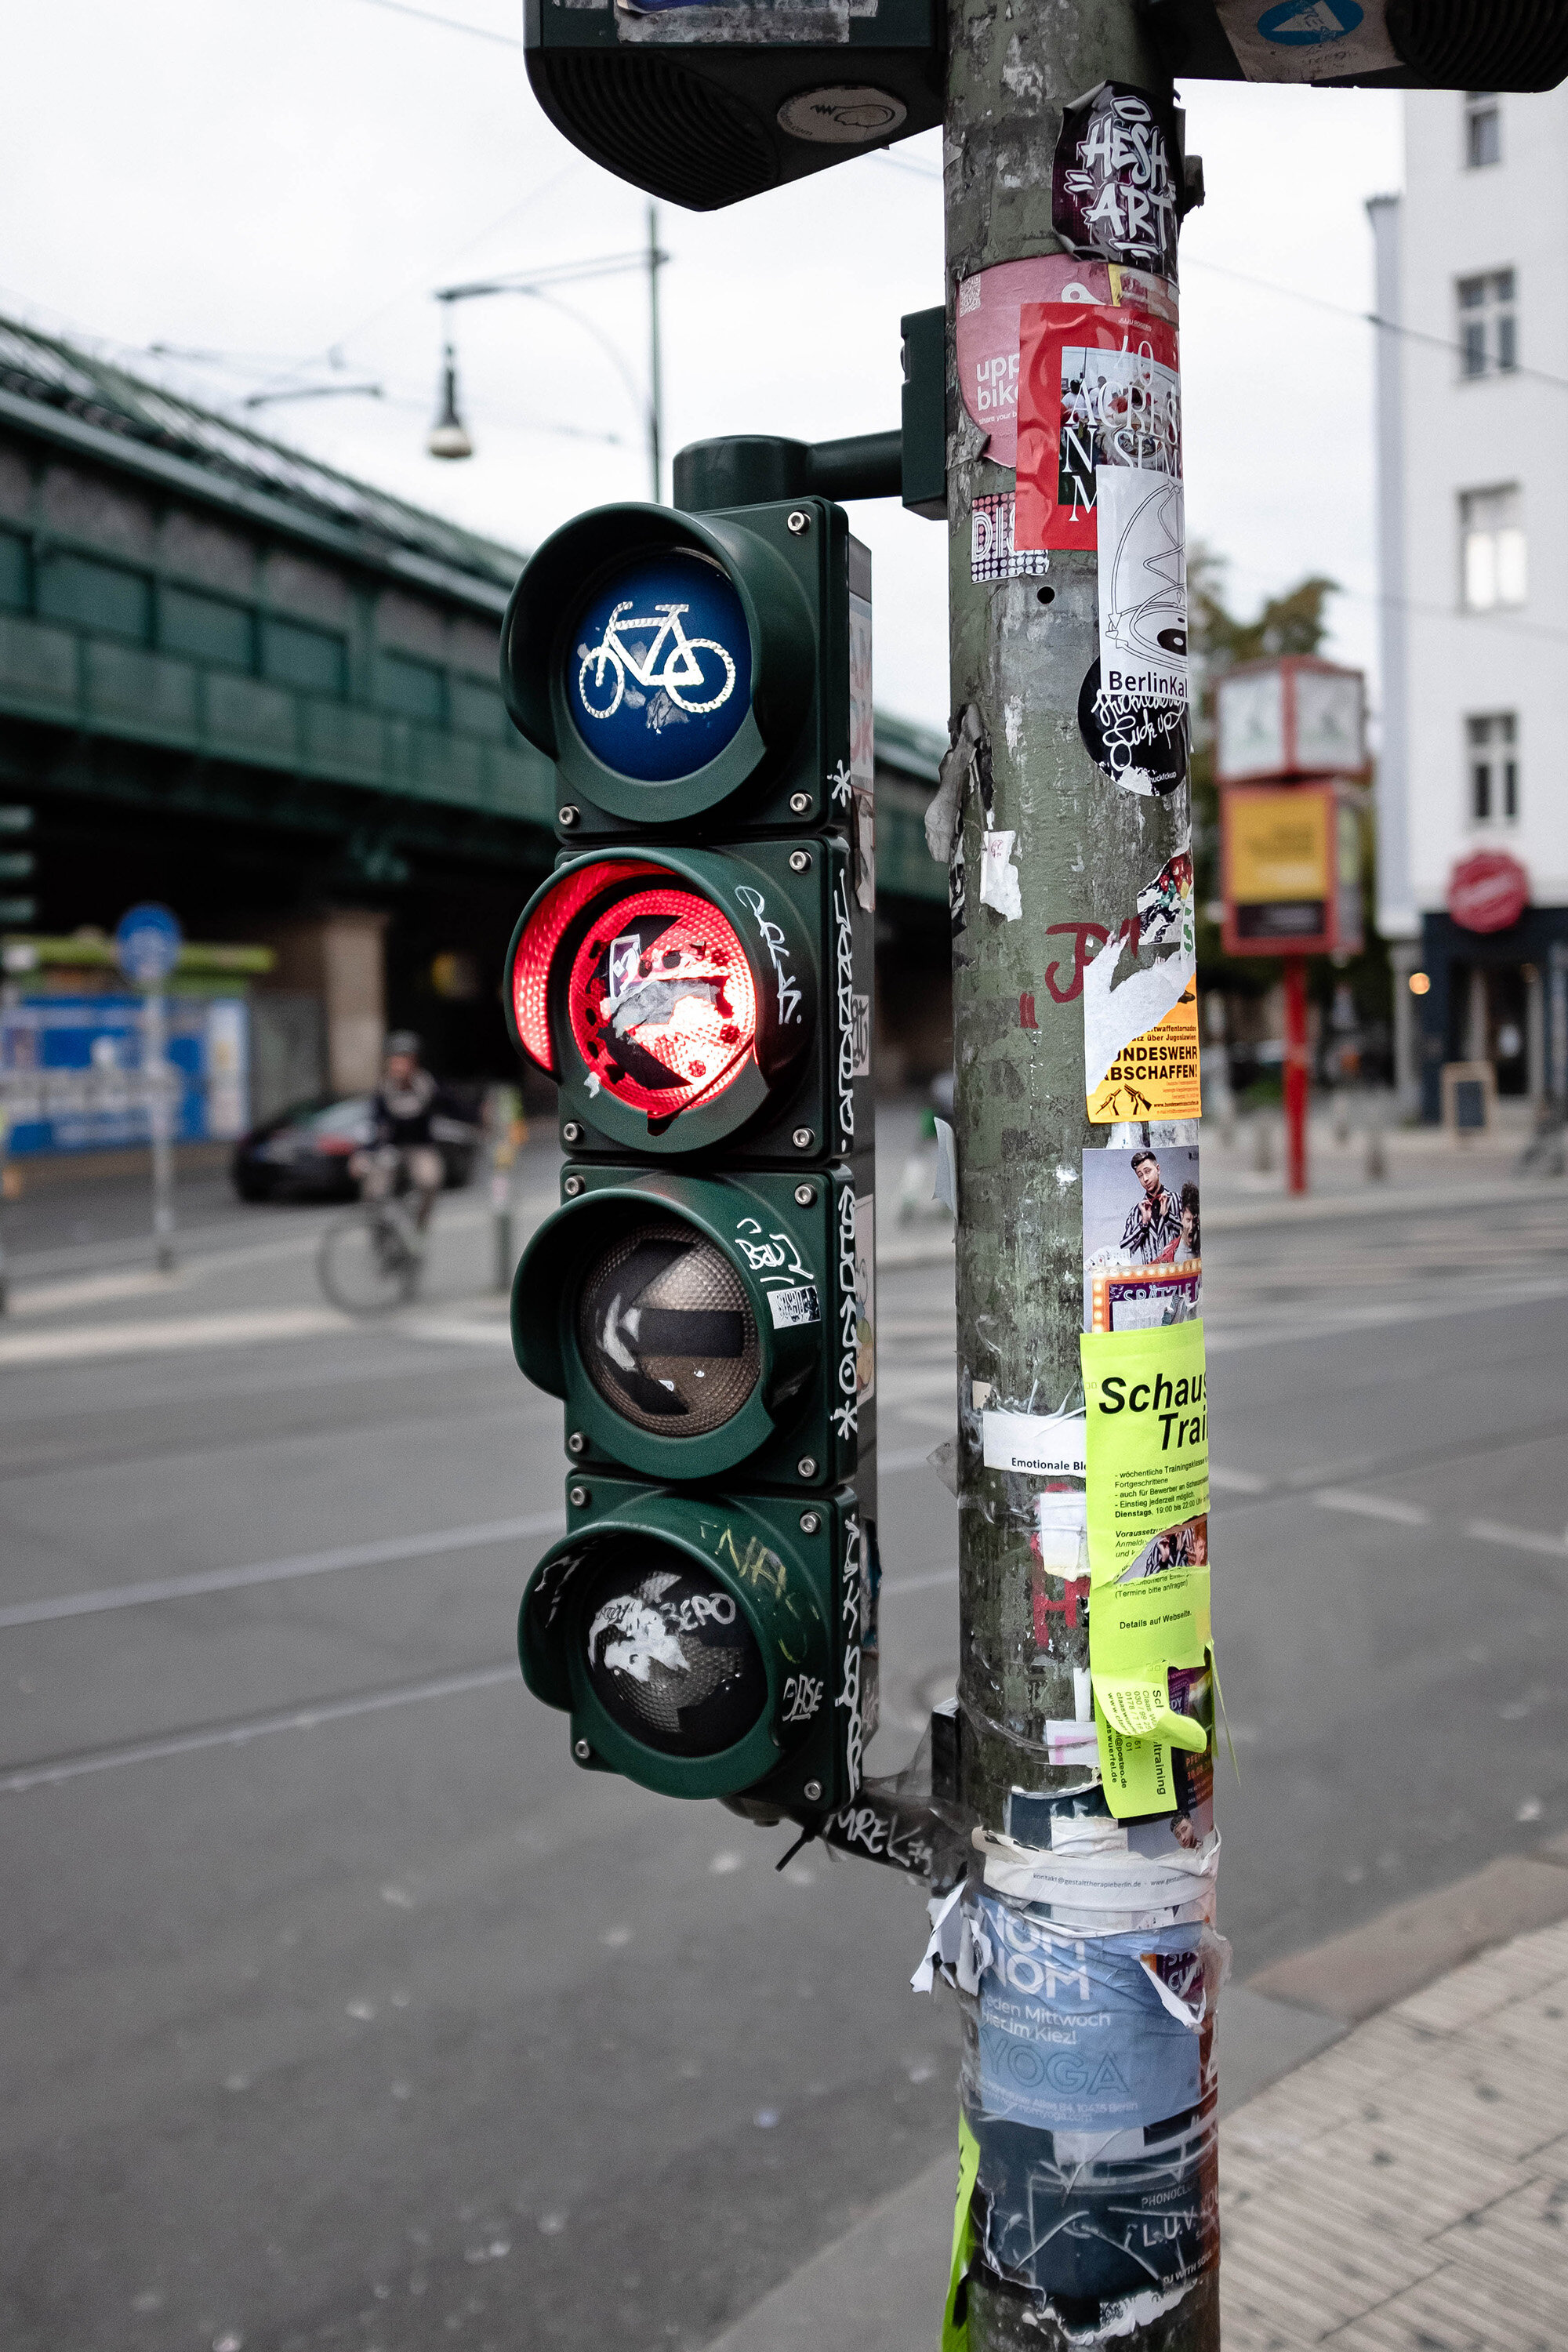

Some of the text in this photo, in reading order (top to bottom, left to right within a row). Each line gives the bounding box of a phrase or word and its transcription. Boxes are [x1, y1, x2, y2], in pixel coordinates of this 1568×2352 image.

[1080, 118, 1168, 189] HESH
[1085, 183, 1172, 251] ART
[996, 412, 1011, 422] your
[1065, 377, 1178, 445] ACRES
[1104, 1064, 1197, 1081] BSCHAFFEN!
[1011, 1457, 1069, 1471] Emotionale
[1120, 1468, 1163, 1478] wöchentliche
[1114, 1478, 1168, 1489] Fortgeschrittene
[1149, 1486, 1178, 1495] Bewerber
[1120, 1500, 1148, 1508] Einstieg
[1149, 1495, 1174, 1507] jederzeit
[1156, 1505, 1172, 1515] 19:00
[1182, 1499, 1196, 1509] 22:00
[1116, 1549, 1129, 1558] und
[1115, 1588, 1146, 1599] (Termine
[1148, 1585, 1162, 1594] bitte
[1163, 1579, 1188, 1591] anfragen)
[1120, 1619, 1147, 1629] Details
[1149, 1617, 1160, 1626] auf
[1125, 1691, 1134, 1711] 0178
[1134, 1690, 1142, 1705] 030
[1025, 2005, 1111, 2027] Mittwoch
[1009, 2018, 1030, 2038] im
[1035, 2024, 1077, 2045] Kiez!
[981, 2029, 1130, 2096] YOGA
